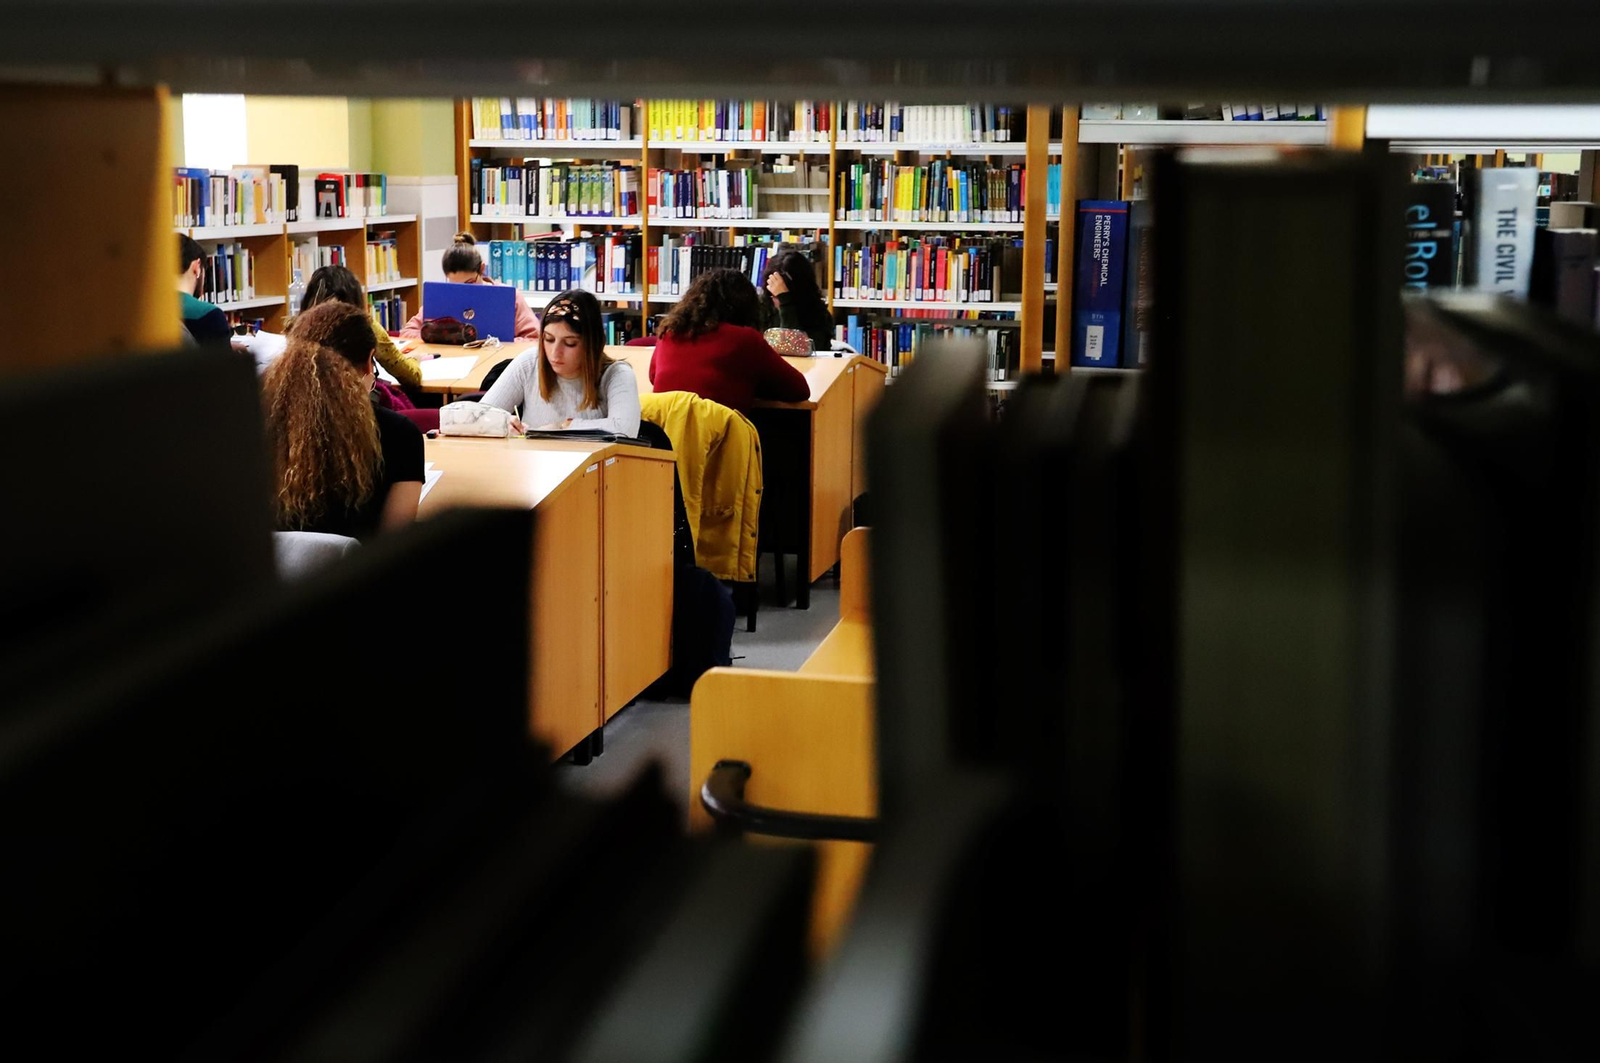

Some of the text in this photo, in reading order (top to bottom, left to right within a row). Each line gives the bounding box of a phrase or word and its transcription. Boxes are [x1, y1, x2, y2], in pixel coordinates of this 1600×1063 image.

[1497, 207, 1518, 239] THE
[1100, 214, 1111, 287] PERRY'S CHEMICAL
[1495, 243, 1517, 284] CIVIL
